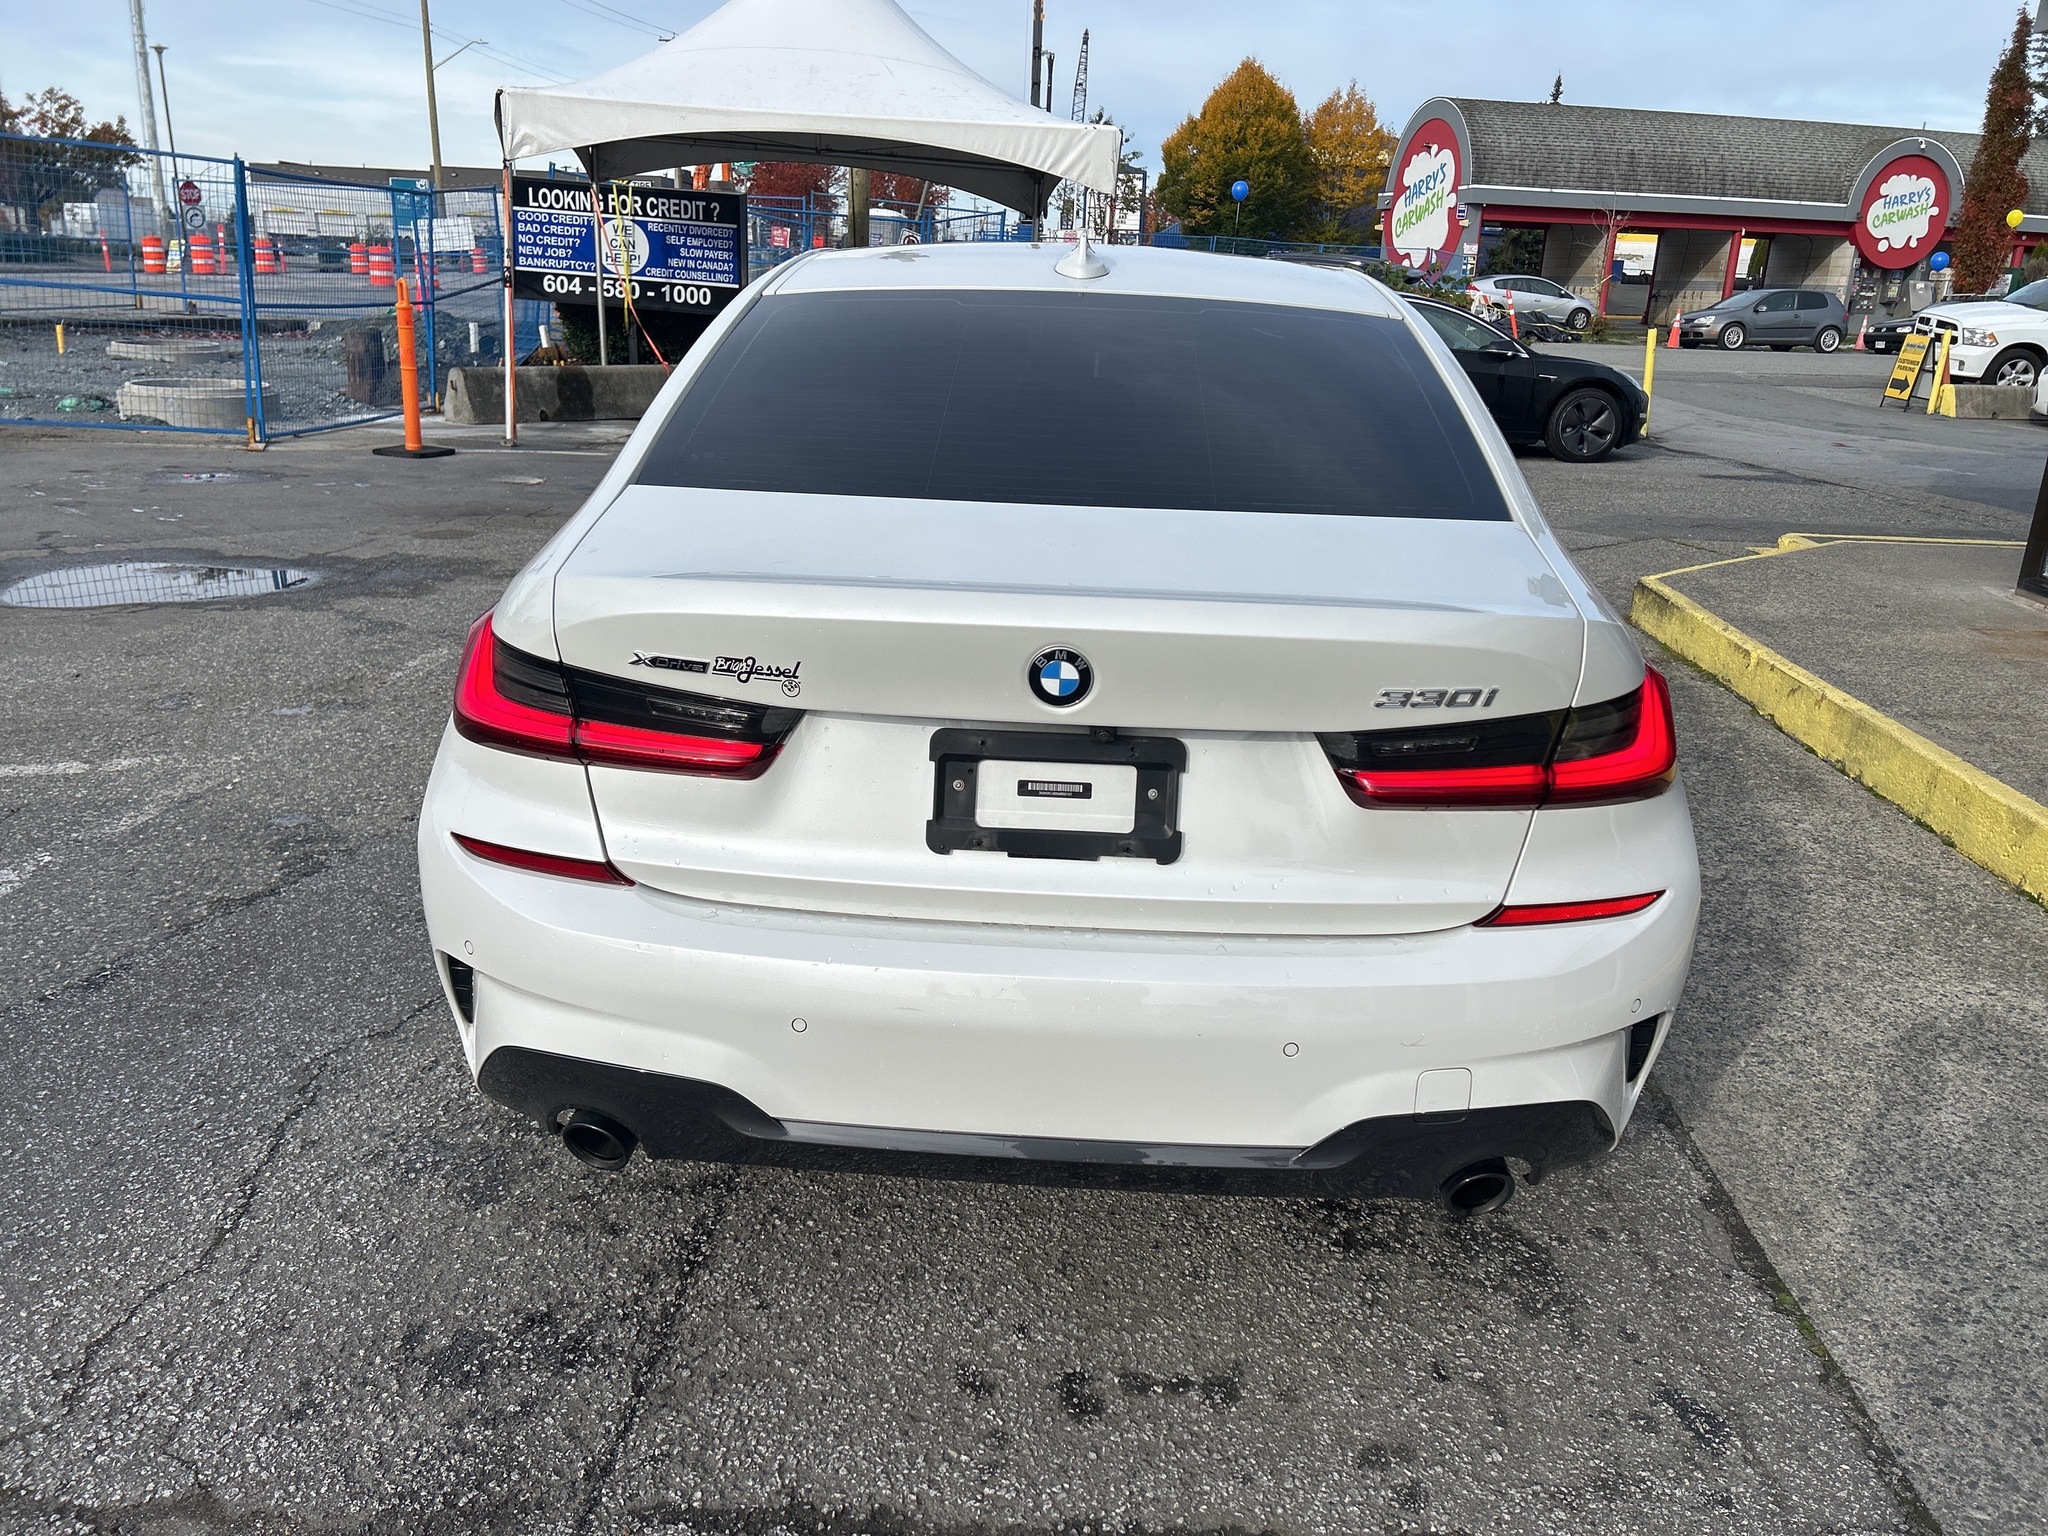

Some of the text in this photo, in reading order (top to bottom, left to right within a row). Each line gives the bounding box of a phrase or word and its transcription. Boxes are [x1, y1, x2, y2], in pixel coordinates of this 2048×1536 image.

[1404, 162, 1447, 208] HARRY'S
[180, 189, 200, 200] STOP
[1883, 186, 1931, 210] HARRY'S
[608, 193, 643, 216] FOR
[646, 197, 706, 220] CREDIT
[710, 202, 720, 221] ?
[1394, 187, 1445, 238] CARWASH
[517, 211, 594, 226] GOOD CREDIT?
[1872, 202, 1930, 228] CARWASH
[518, 223, 587, 236] BAD CREDIT?
[612, 224, 633, 236] WE
[647, 222, 733, 238] RECENTLY DIVORCED?
[518, 234, 581, 248] NO CREDIT?
[610, 238, 636, 250] CAN
[666, 235, 733, 249] SELF EMPLOYED?
[518, 245, 573, 258] NEW JOB?
[605, 252, 641, 265] HEP!
[680, 248, 733, 261] SLOW PAYER?
[518, 256, 596, 271] BANKRUPTCY?
[668, 258, 734, 271] NEW IN CANADA?
[645, 267, 734, 282] CREDIT COUNSELLING?
[543, 275, 582, 295] 604
[602, 279, 641, 299] 580
[661, 284, 711, 306] 1000
[1896, 364, 1915, 373] PARKING
[1898, 357, 1920, 367] CUSTOMER
[714, 656, 801, 683] Brian Jessel
[1374, 687, 1499, 708] 330i
